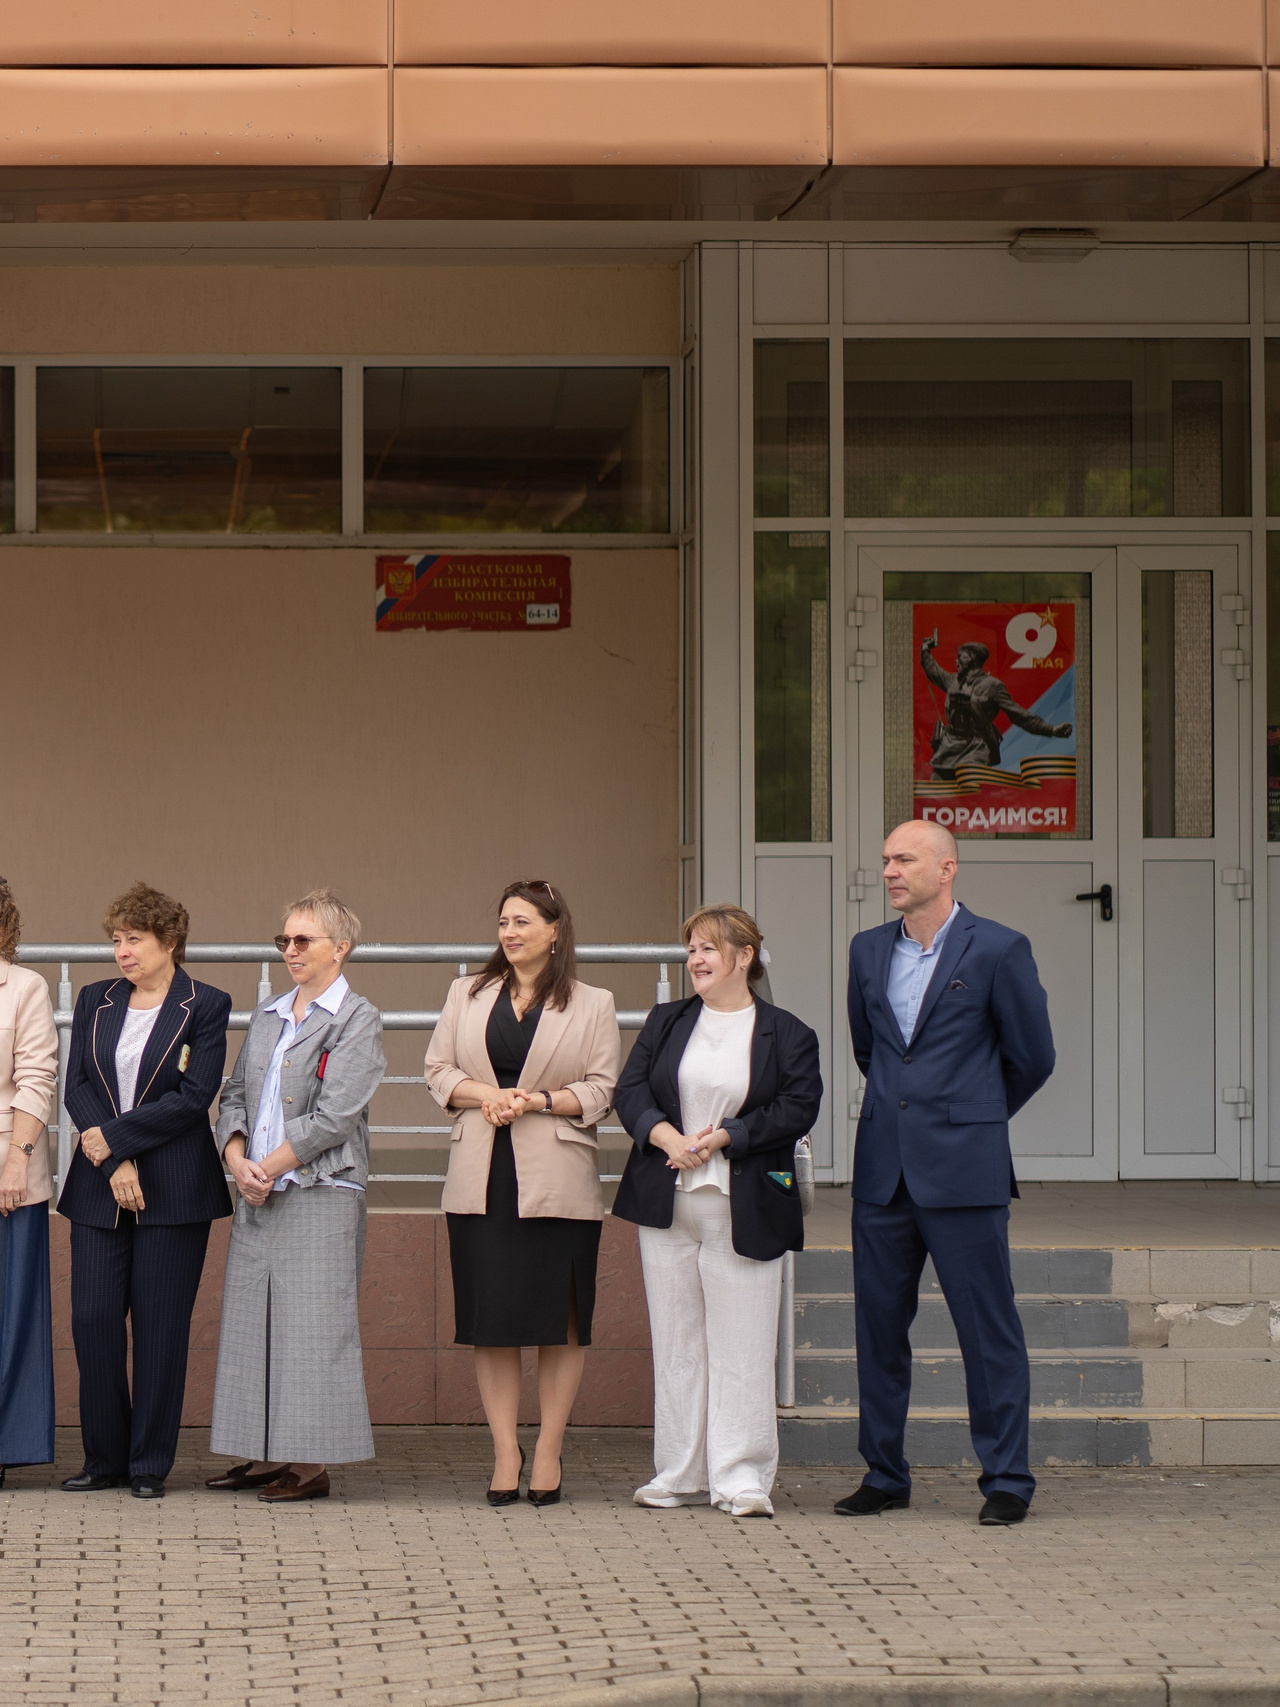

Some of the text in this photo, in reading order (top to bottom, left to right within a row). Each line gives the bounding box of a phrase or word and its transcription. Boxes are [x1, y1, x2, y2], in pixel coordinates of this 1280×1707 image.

[447, 563, 543, 575] УЧАСТКОВАЯ
[433, 577, 557, 588] ИЗБИРАТЕЛЬНАЯ
[454, 590, 536, 601] КОМИССИЯ
[387, 611, 468, 621] ИЗБИРАТЕЛЬНОГО
[471, 611, 511, 623] УЧАСТКА
[528, 608, 559, 619] 64-14
[1005, 611, 1064, 669] 9 МАЯ
[922, 806, 1067, 829] ГОРДИМСЯ!
